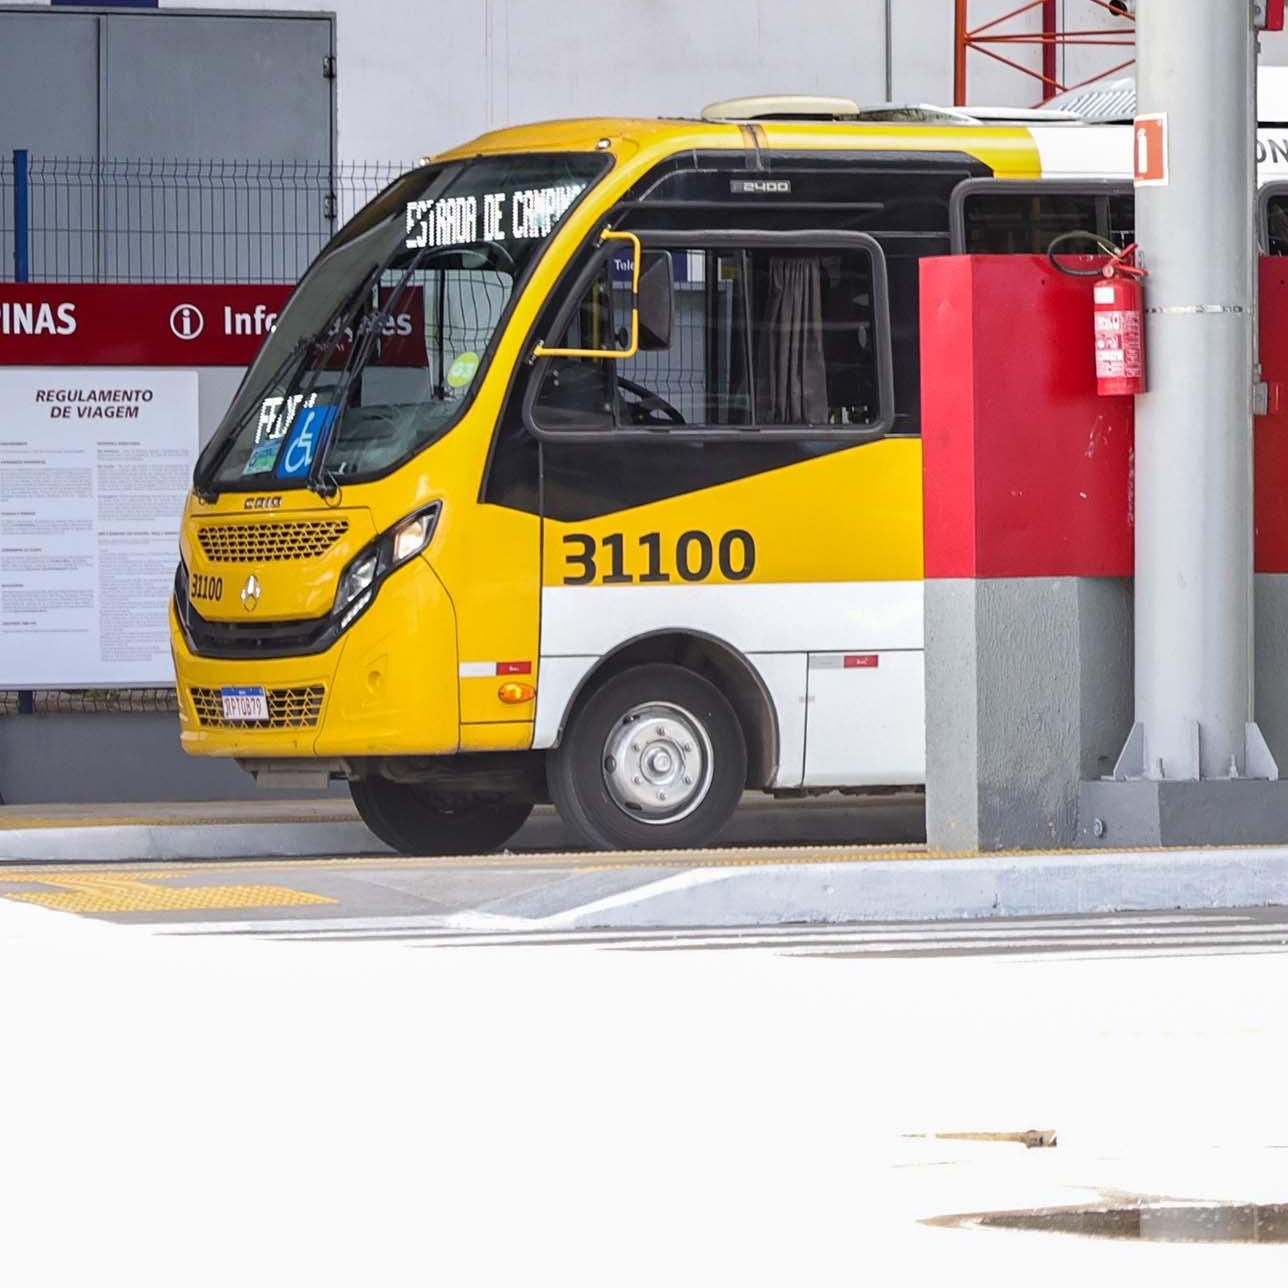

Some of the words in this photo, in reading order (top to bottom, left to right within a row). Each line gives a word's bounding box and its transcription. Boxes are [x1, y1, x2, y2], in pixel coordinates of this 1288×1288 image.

[406, 196, 477, 248] ESTRADA
[483, 193, 505, 241] DE
[0, 302, 77, 336] INAS
[36, 389, 153, 403] REGULAMENTO
[50, 406, 70, 418] DE
[76, 406, 139, 419] VIAGEM
[244, 496, 282, 509] CAIO
[562, 529, 756, 586] 31100
[191, 574, 223, 601] 31100
